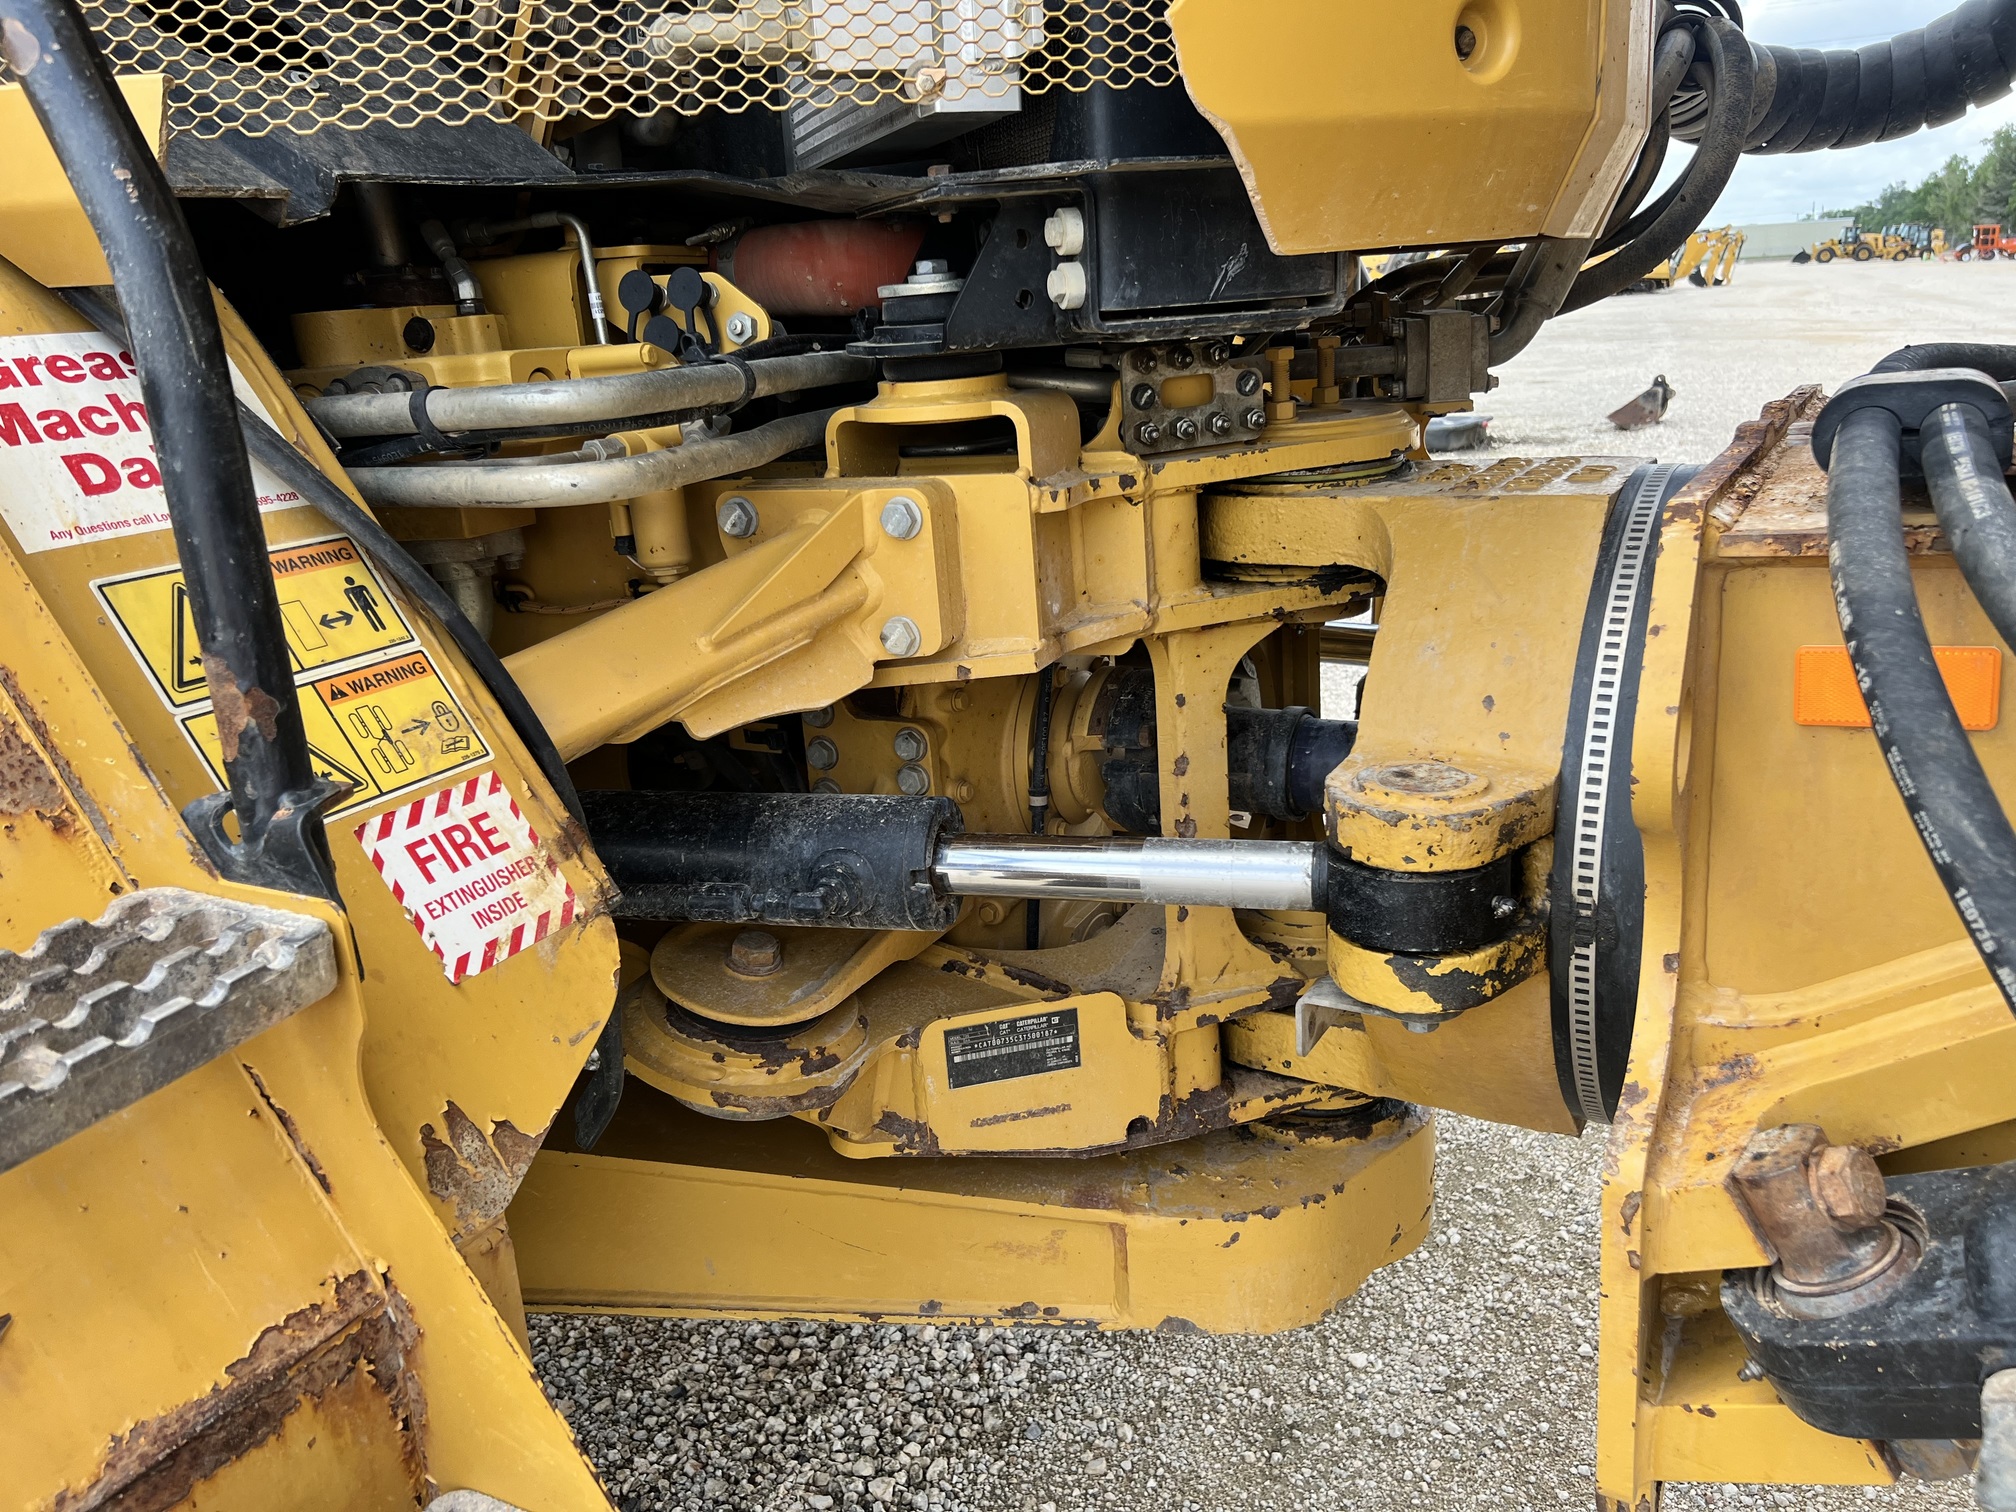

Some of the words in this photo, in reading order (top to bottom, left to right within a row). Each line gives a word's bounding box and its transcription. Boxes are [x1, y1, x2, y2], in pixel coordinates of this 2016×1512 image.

[61, 445, 164, 497] Da
[50, 528, 73, 541] Any
[75, 519, 131, 537] Questions
[133, 513, 154, 527] call
[270, 547, 353, 574] WARNING
[346, 661, 428, 694] WARNING
[404, 811, 510, 885] FIRE
[424, 856, 541, 921] EXTINGUISHER
[471, 891, 528, 929] INSIDE
